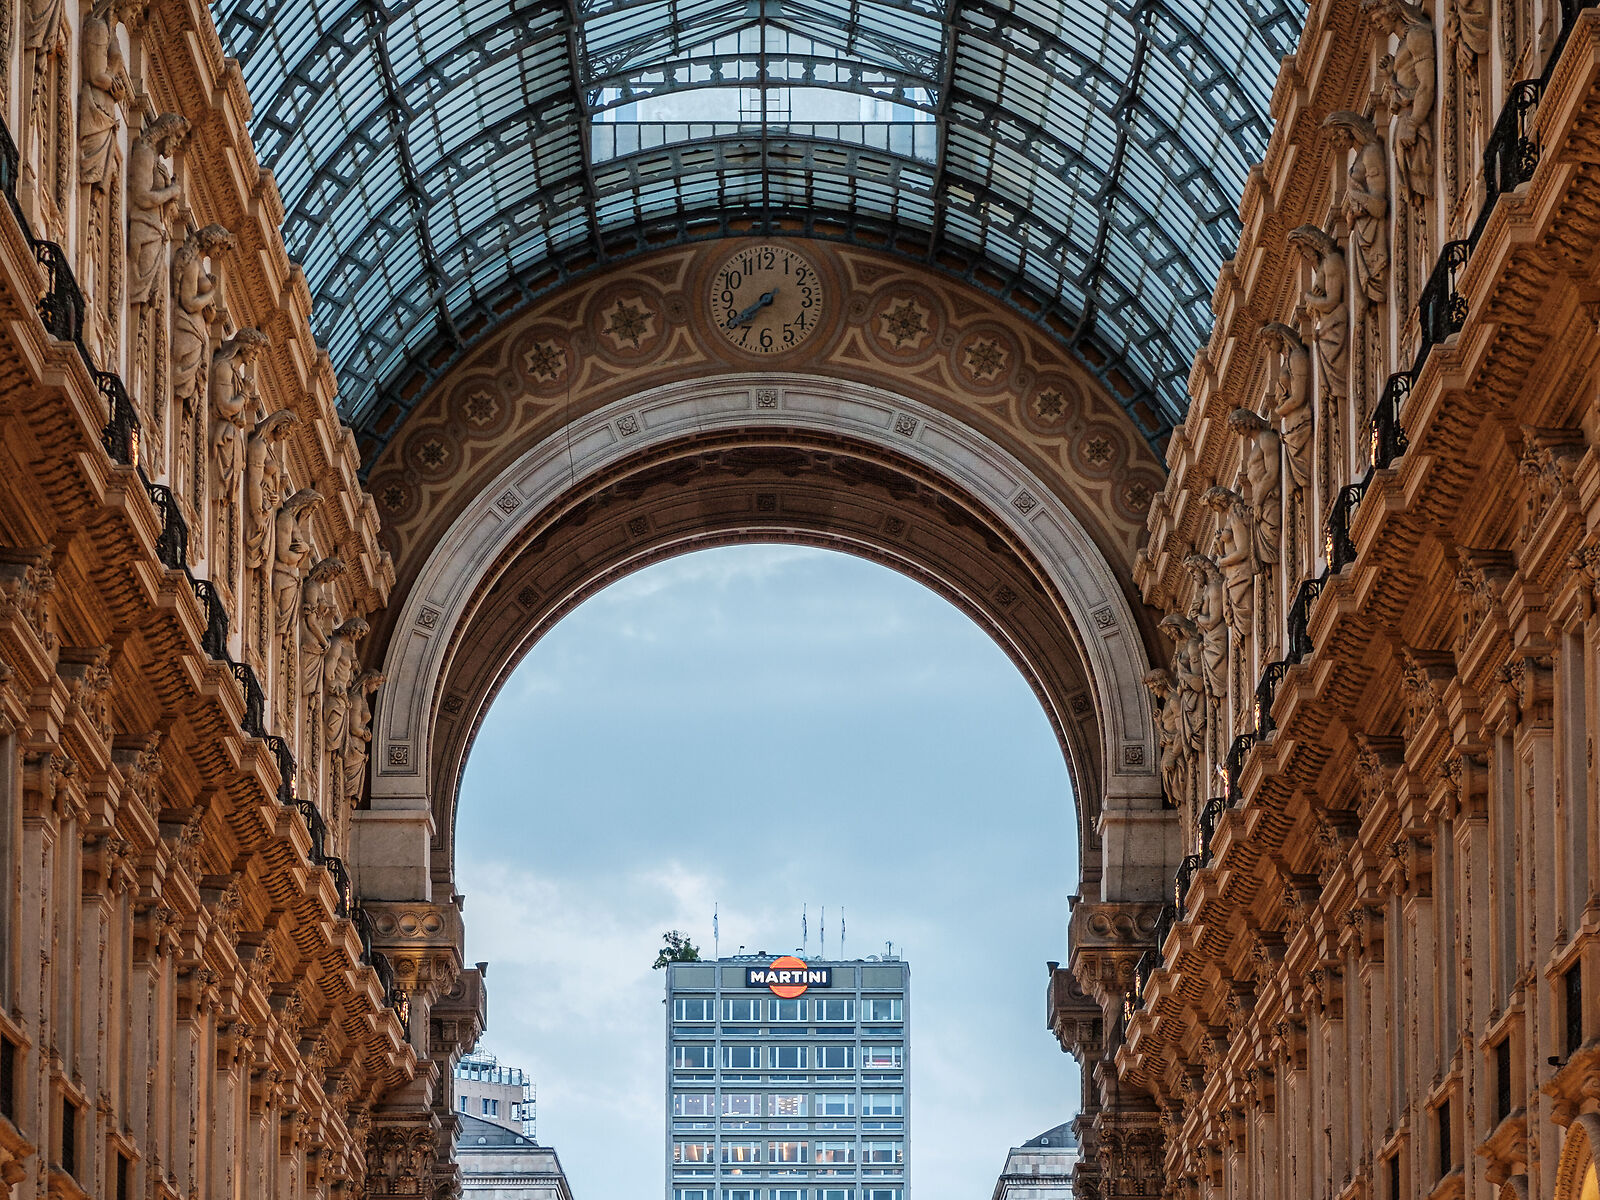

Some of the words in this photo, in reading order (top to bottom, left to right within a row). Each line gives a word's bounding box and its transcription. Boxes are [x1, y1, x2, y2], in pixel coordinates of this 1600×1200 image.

[741, 257, 753, 275] 11
[757, 251, 775, 270] 12
[783, 257, 789, 274] 1
[724, 270, 742, 289] 10
[795, 267, 807, 286] 2
[721, 290, 733, 309] 9
[801, 287, 813, 308] 3
[726, 309, 738, 329] 8
[794, 310, 807, 330] 4
[741, 325, 752, 342] 7
[759, 328, 773, 347] 6
[783, 323, 795, 342] 5
[750, 970, 827, 983] MARTINI
